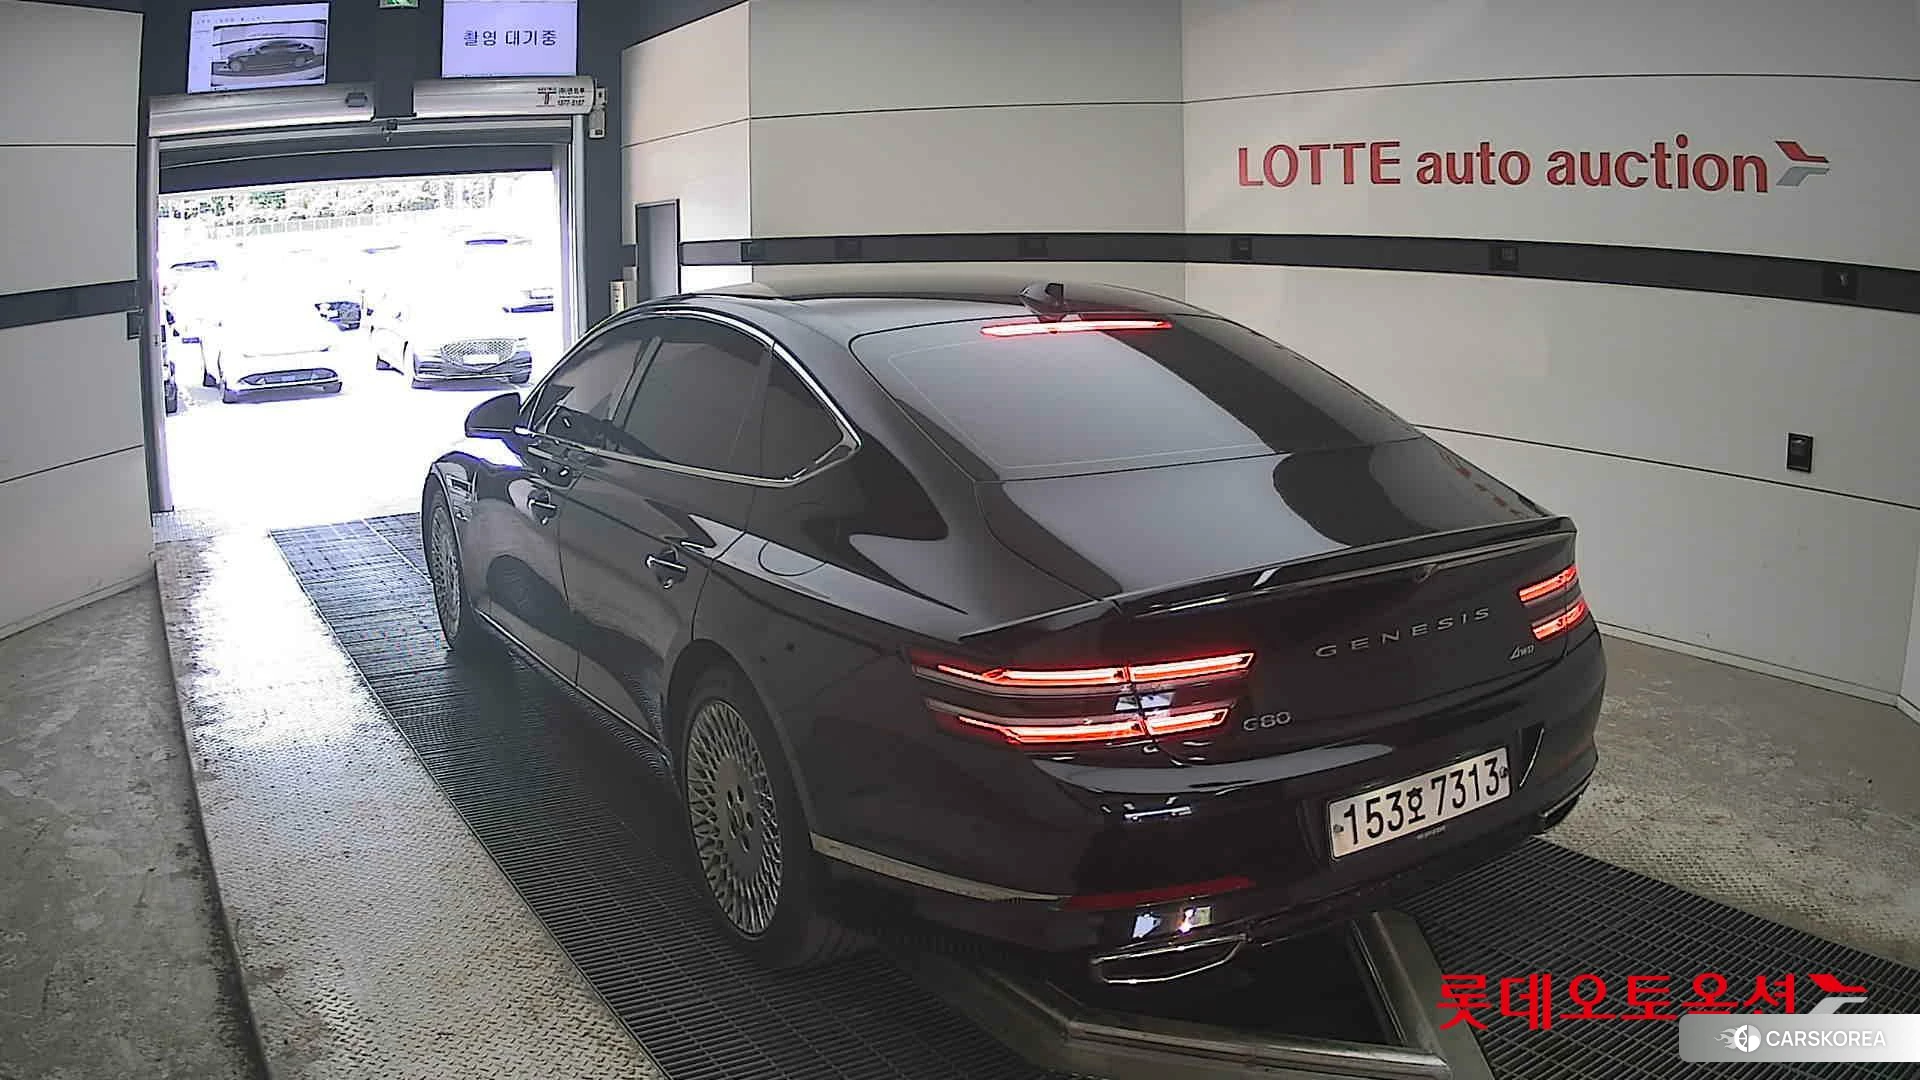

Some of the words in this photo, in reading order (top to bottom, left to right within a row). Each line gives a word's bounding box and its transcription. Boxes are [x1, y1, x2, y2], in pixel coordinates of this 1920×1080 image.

[463, 30, 497, 47] 촬영
[505, 30, 557, 47] 대기중
[1238, 141, 1401, 187] LOTTE
[1416, 142, 1532, 186] auto
[1546, 134, 1769, 193] auction
[1315, 607, 1489, 657] GENESIS
[1243, 711, 1290, 731] G80
[1343, 787, 1426, 845] 153호
[1431, 756, 1500, 816] 7313
